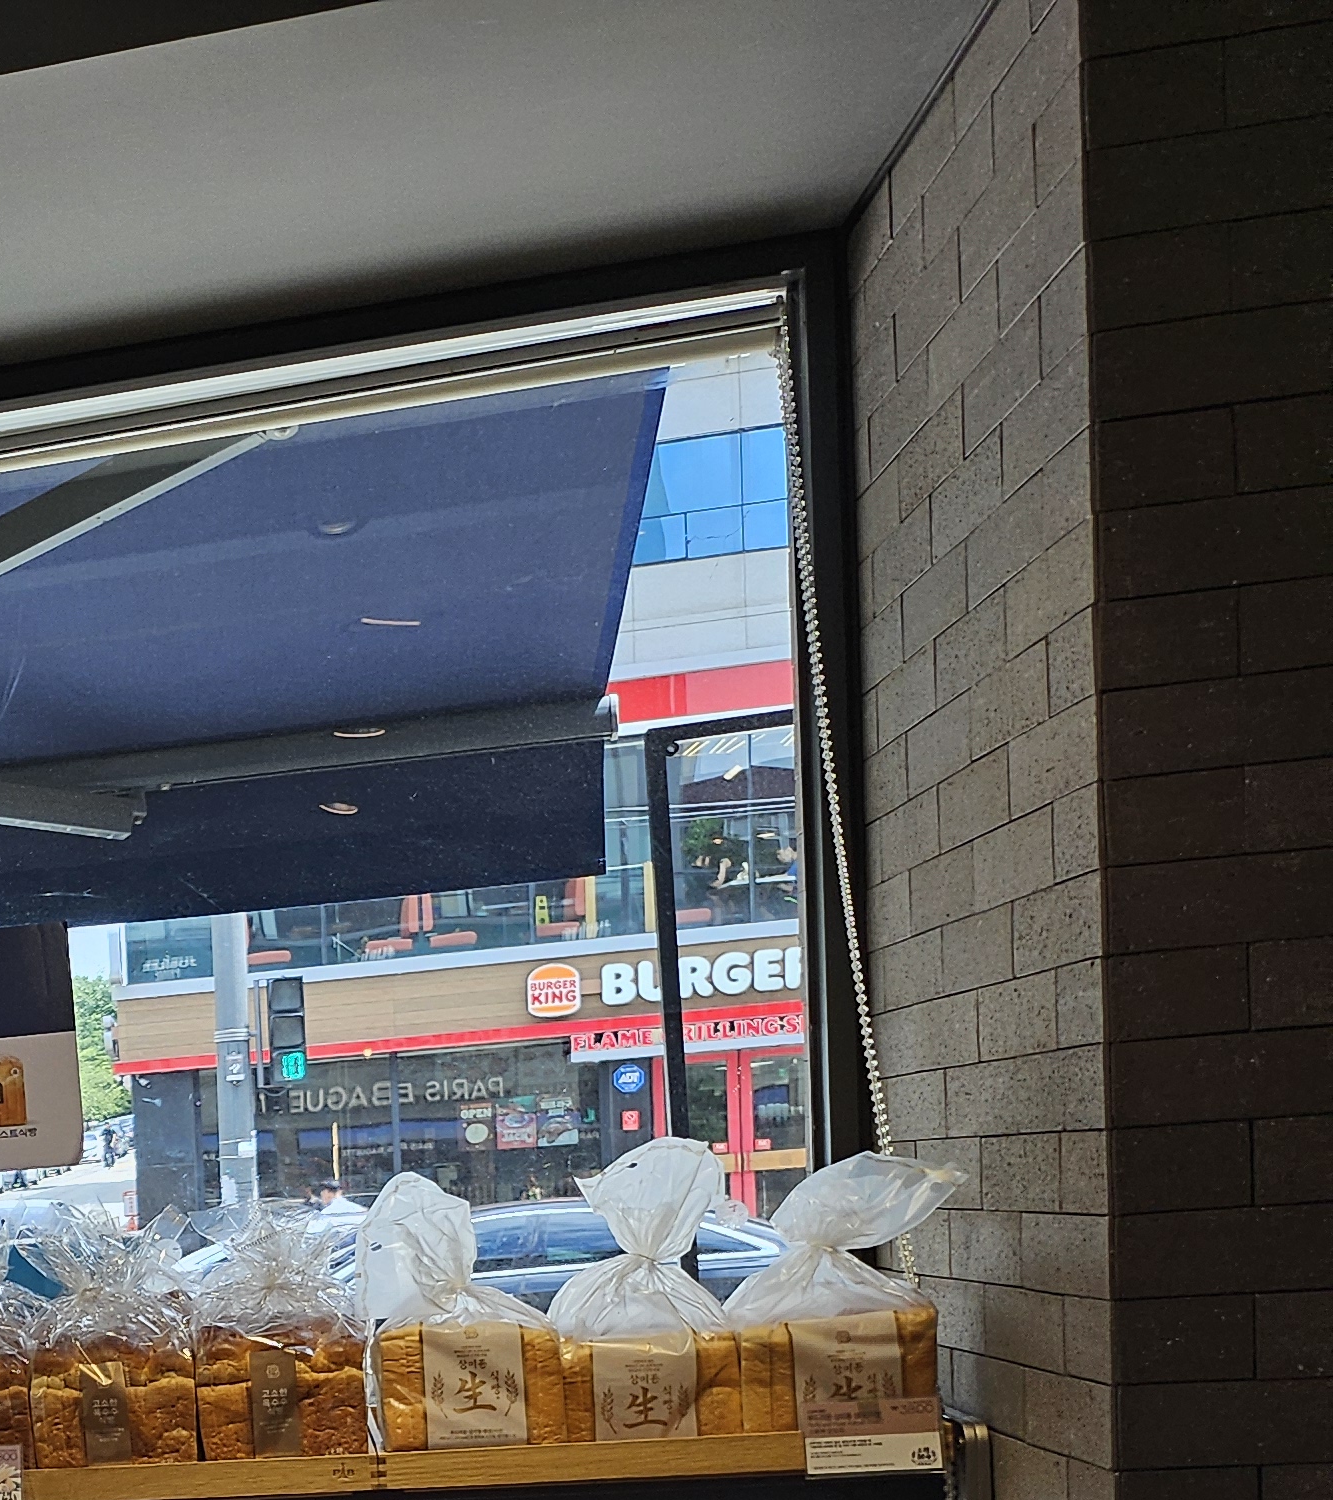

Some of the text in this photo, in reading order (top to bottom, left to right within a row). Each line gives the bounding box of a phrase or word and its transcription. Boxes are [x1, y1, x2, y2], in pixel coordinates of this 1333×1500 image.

[530, 979, 577, 992] BURGER
[530, 990, 577, 1006] KING
[570, 1029, 654, 1051] FLAME
[453, 1370, 497, 1414] 生
[623, 1385, 667, 1428] 生
